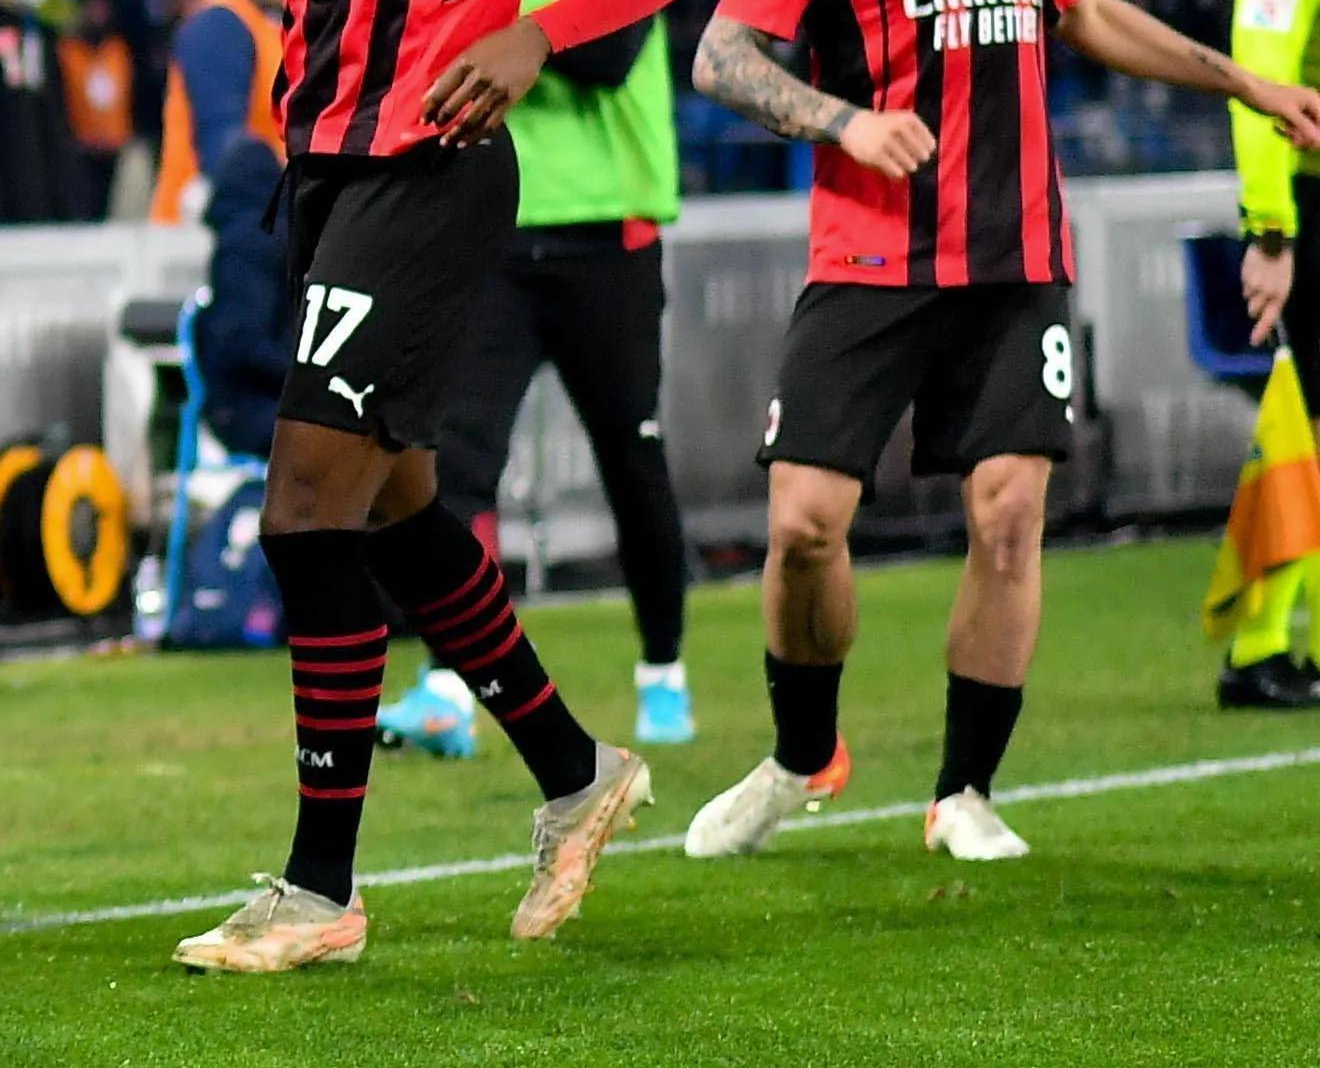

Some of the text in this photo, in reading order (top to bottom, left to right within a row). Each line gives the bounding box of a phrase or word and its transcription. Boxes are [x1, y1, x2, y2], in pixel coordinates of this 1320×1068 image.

[933, 10, 972, 51] FLY
[297, 284, 373, 366] 17
[1042, 325, 1074, 399] 8
